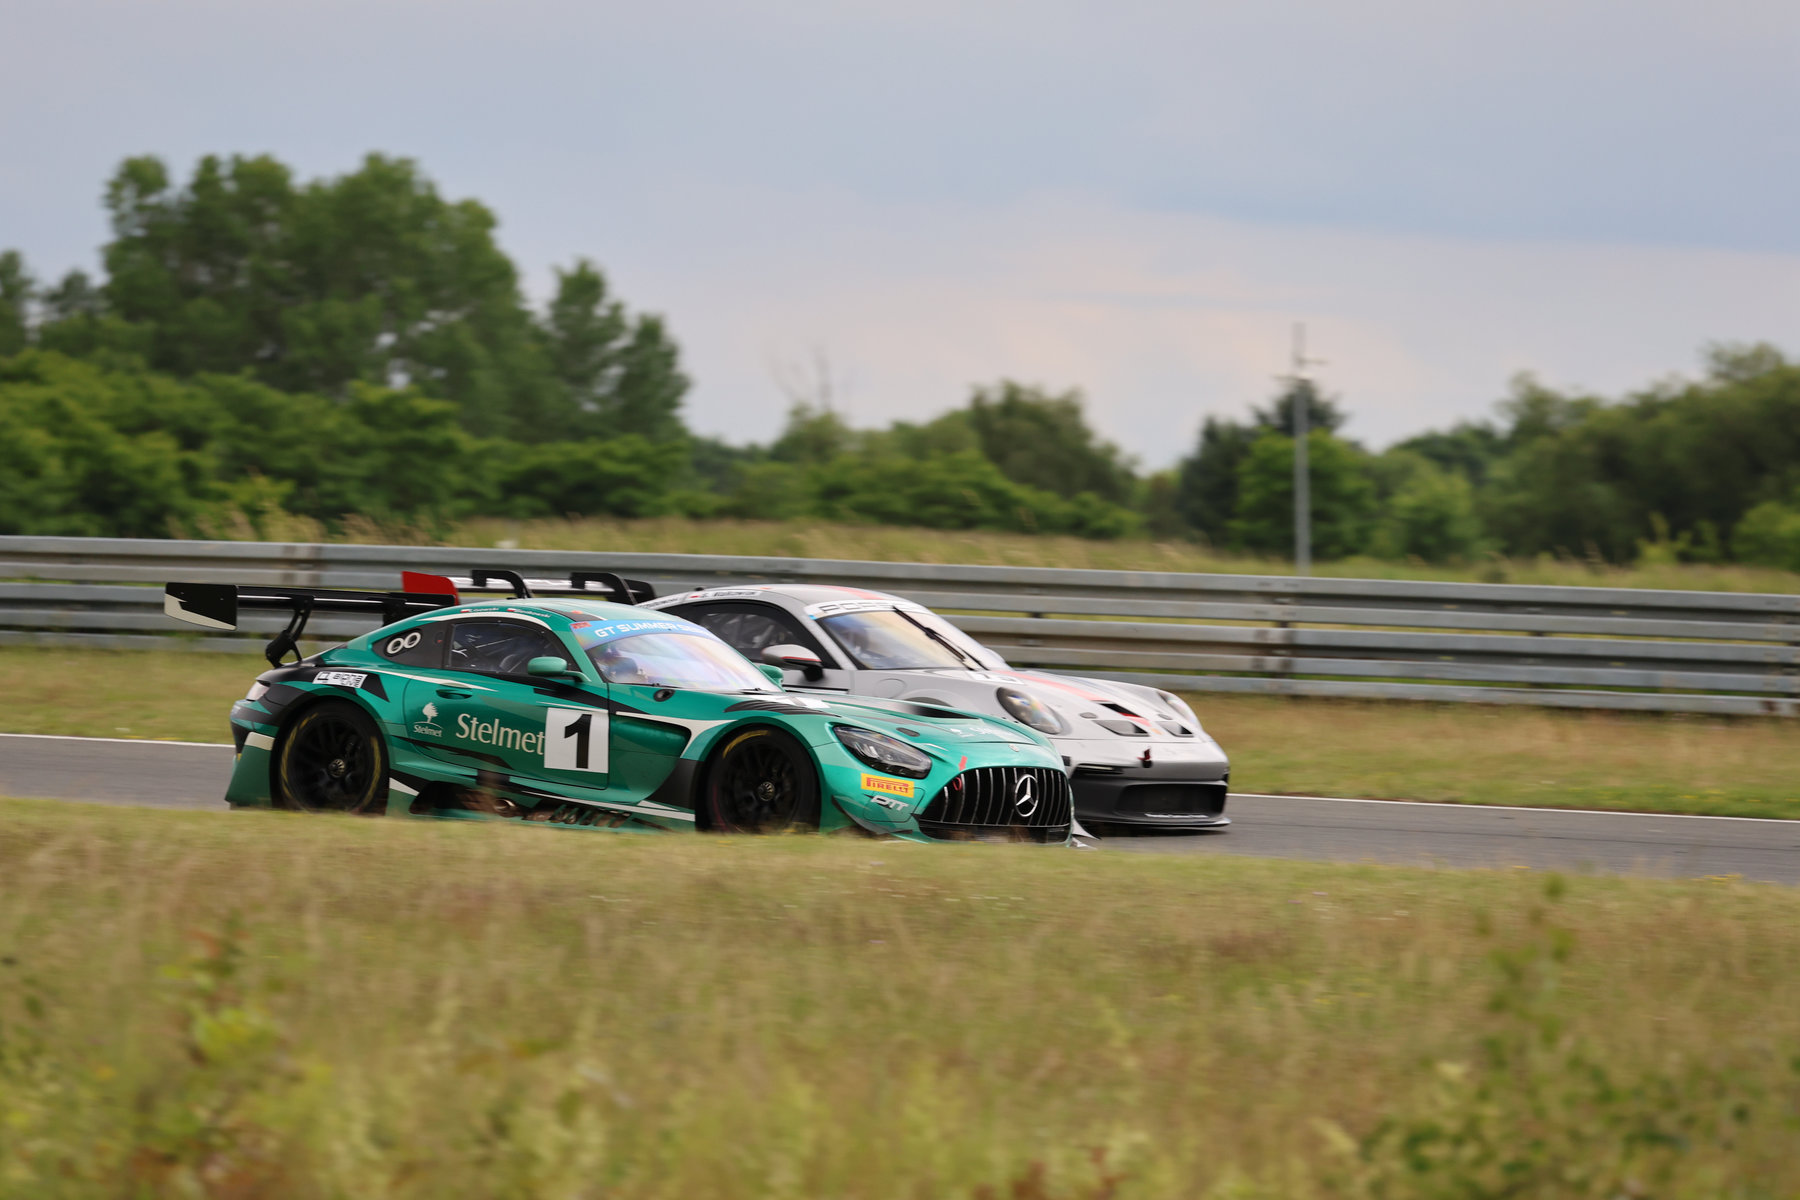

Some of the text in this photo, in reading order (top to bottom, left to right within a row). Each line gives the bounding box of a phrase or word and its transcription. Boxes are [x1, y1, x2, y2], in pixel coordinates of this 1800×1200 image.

[594, 626, 616, 638] GT
[619, 622, 678, 633] SUMMER
[455, 713, 546, 756] Stelmet
[563, 713, 592, 769] 1
[866, 777, 909, 794] PIRELLI
